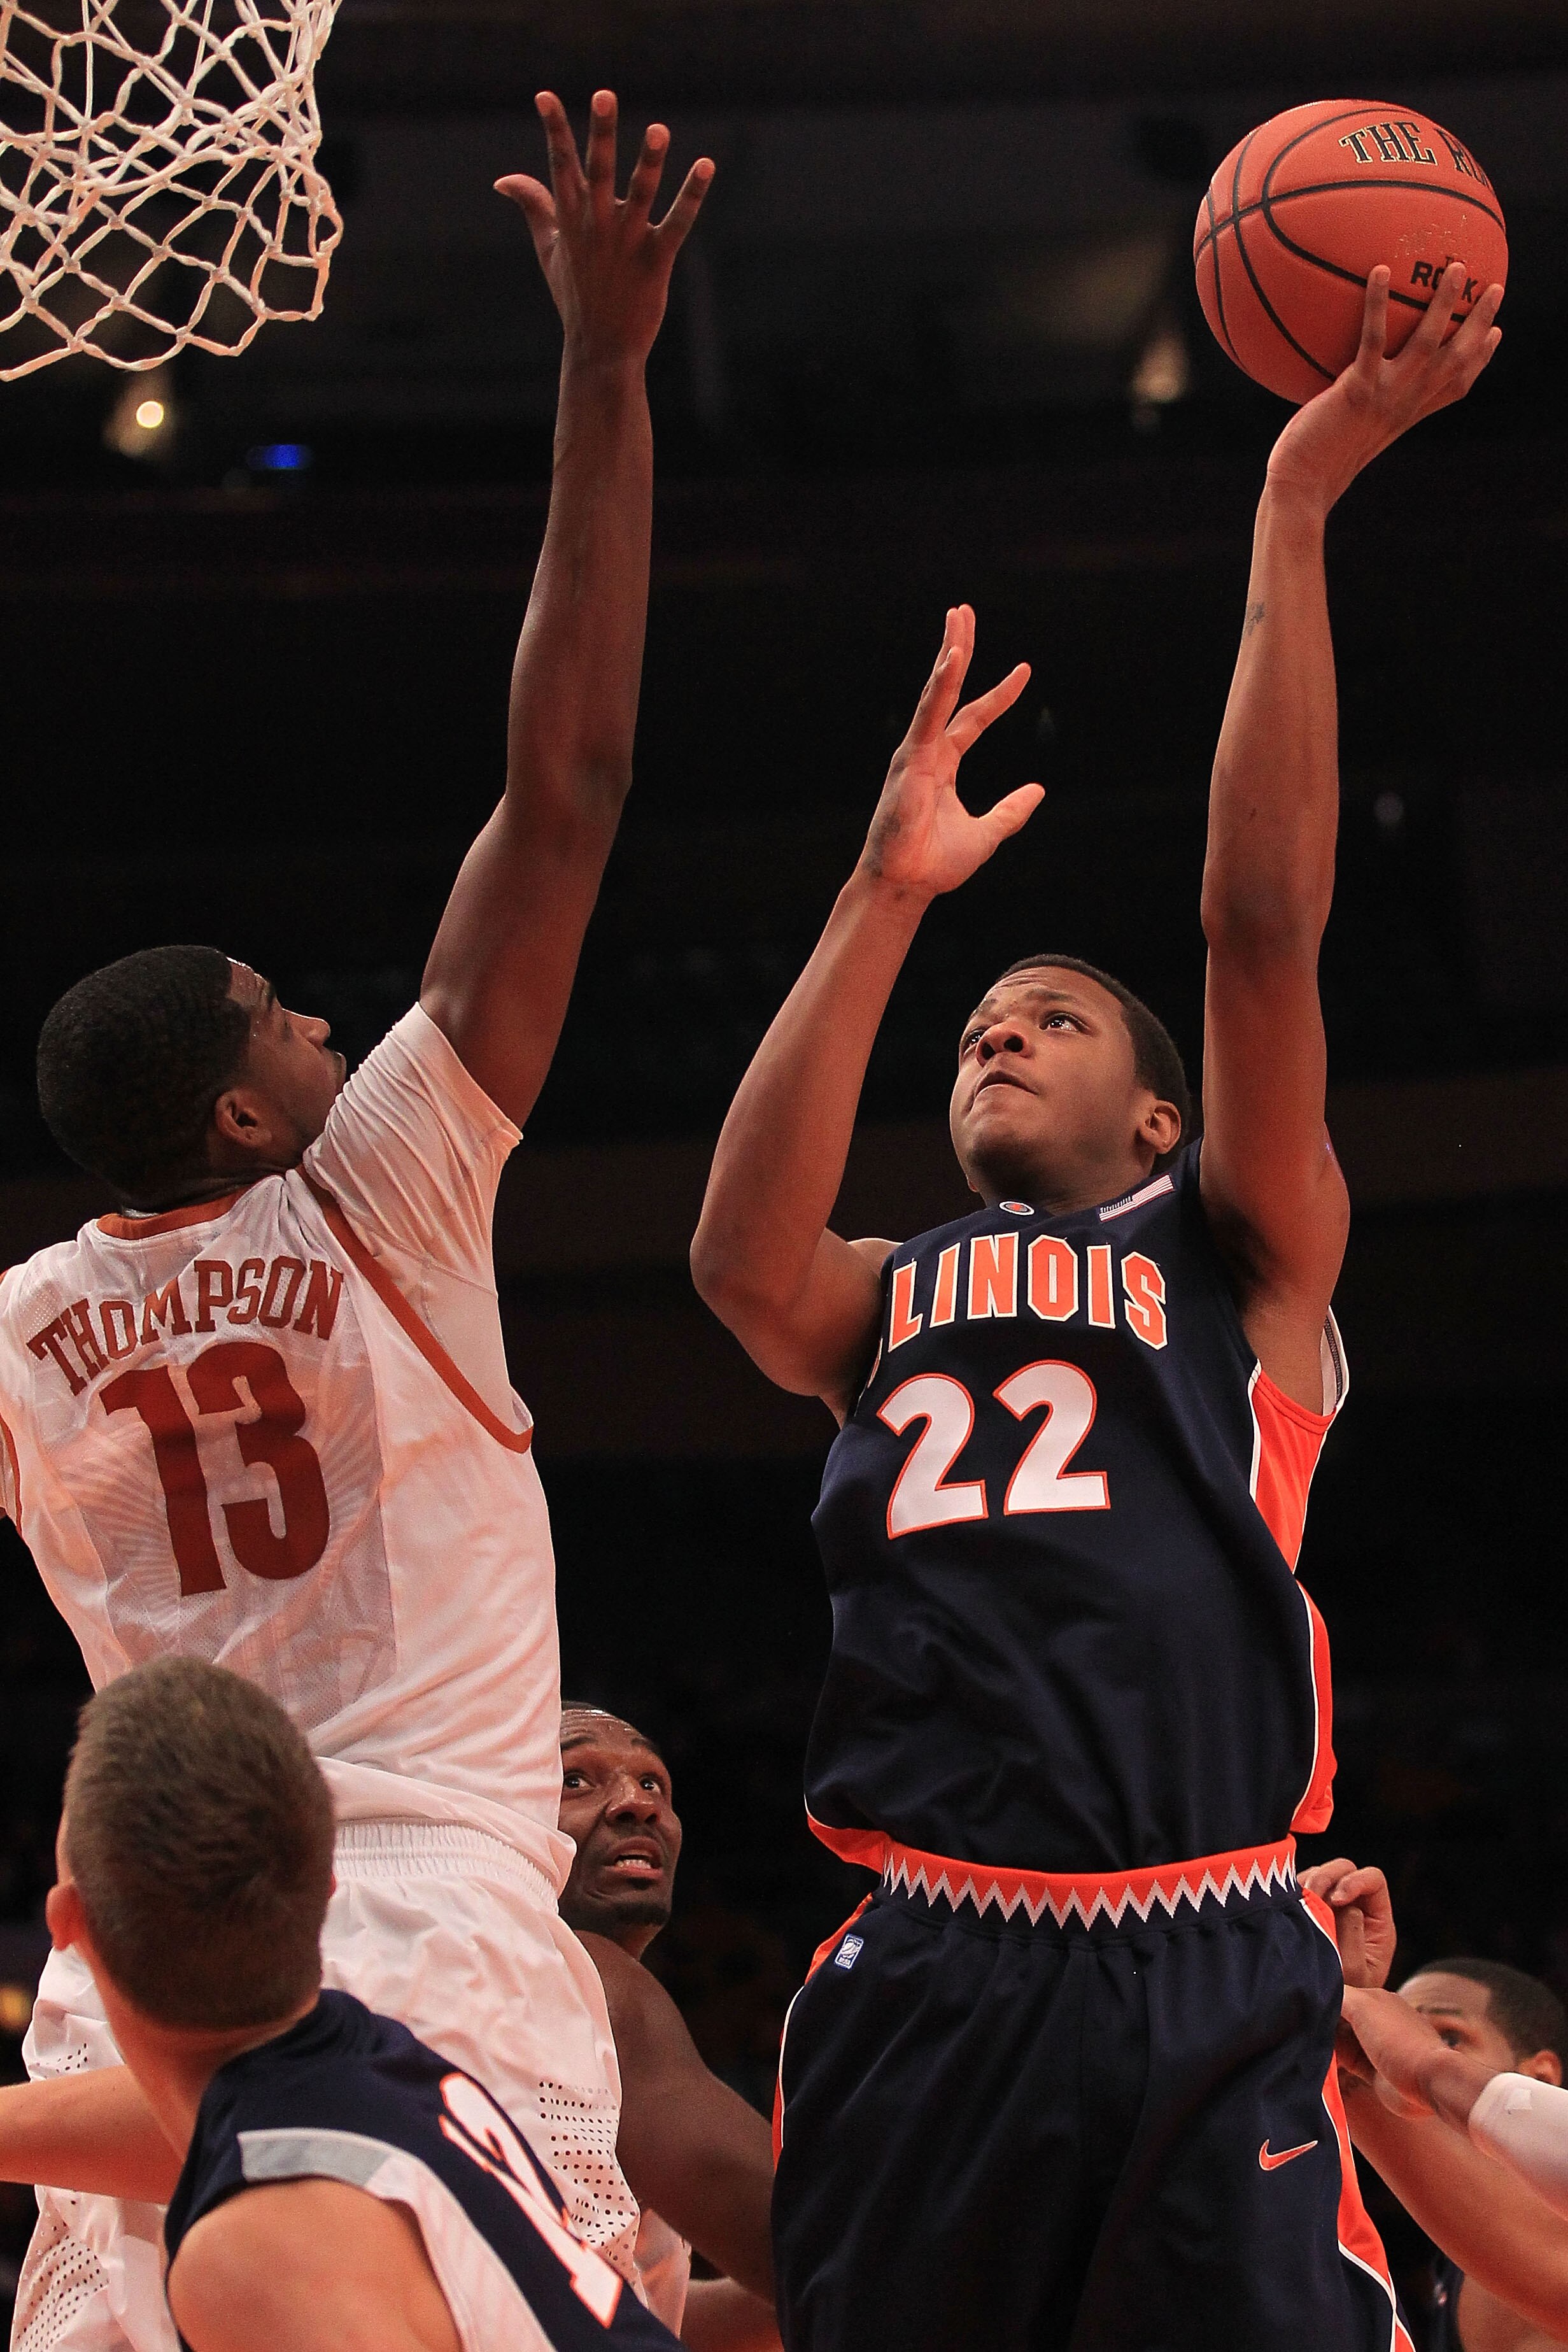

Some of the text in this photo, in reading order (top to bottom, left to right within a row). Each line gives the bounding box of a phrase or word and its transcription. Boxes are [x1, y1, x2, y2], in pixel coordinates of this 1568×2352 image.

[1338, 121, 1438, 166] THE
[27, 1255, 344, 1396] THOMPSON
[871, 1231, 1168, 1352] LINOIS
[99, 1342, 330, 1596] 13
[876, 1359, 1111, 1540] 22
